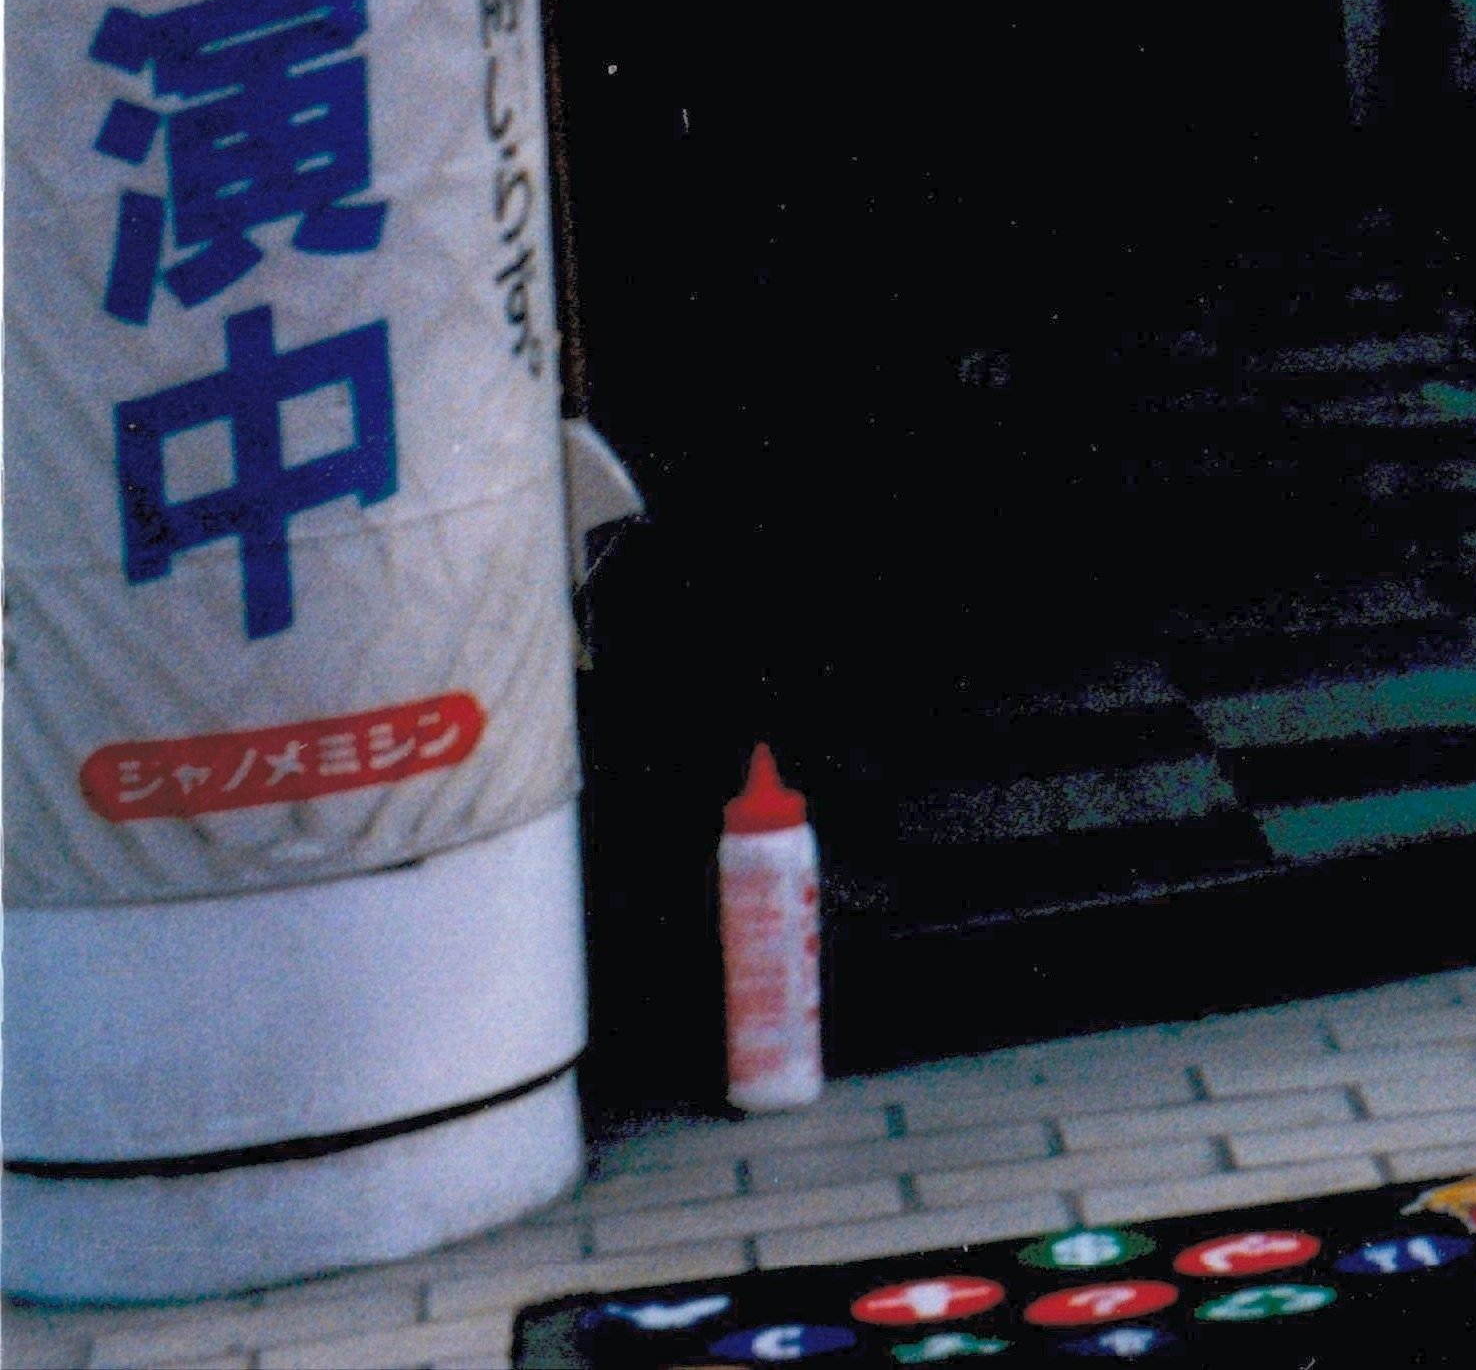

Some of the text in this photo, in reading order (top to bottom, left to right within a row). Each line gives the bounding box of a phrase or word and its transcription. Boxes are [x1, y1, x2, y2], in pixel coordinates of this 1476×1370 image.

[118, 711, 463, 801] ジャノメミシン
